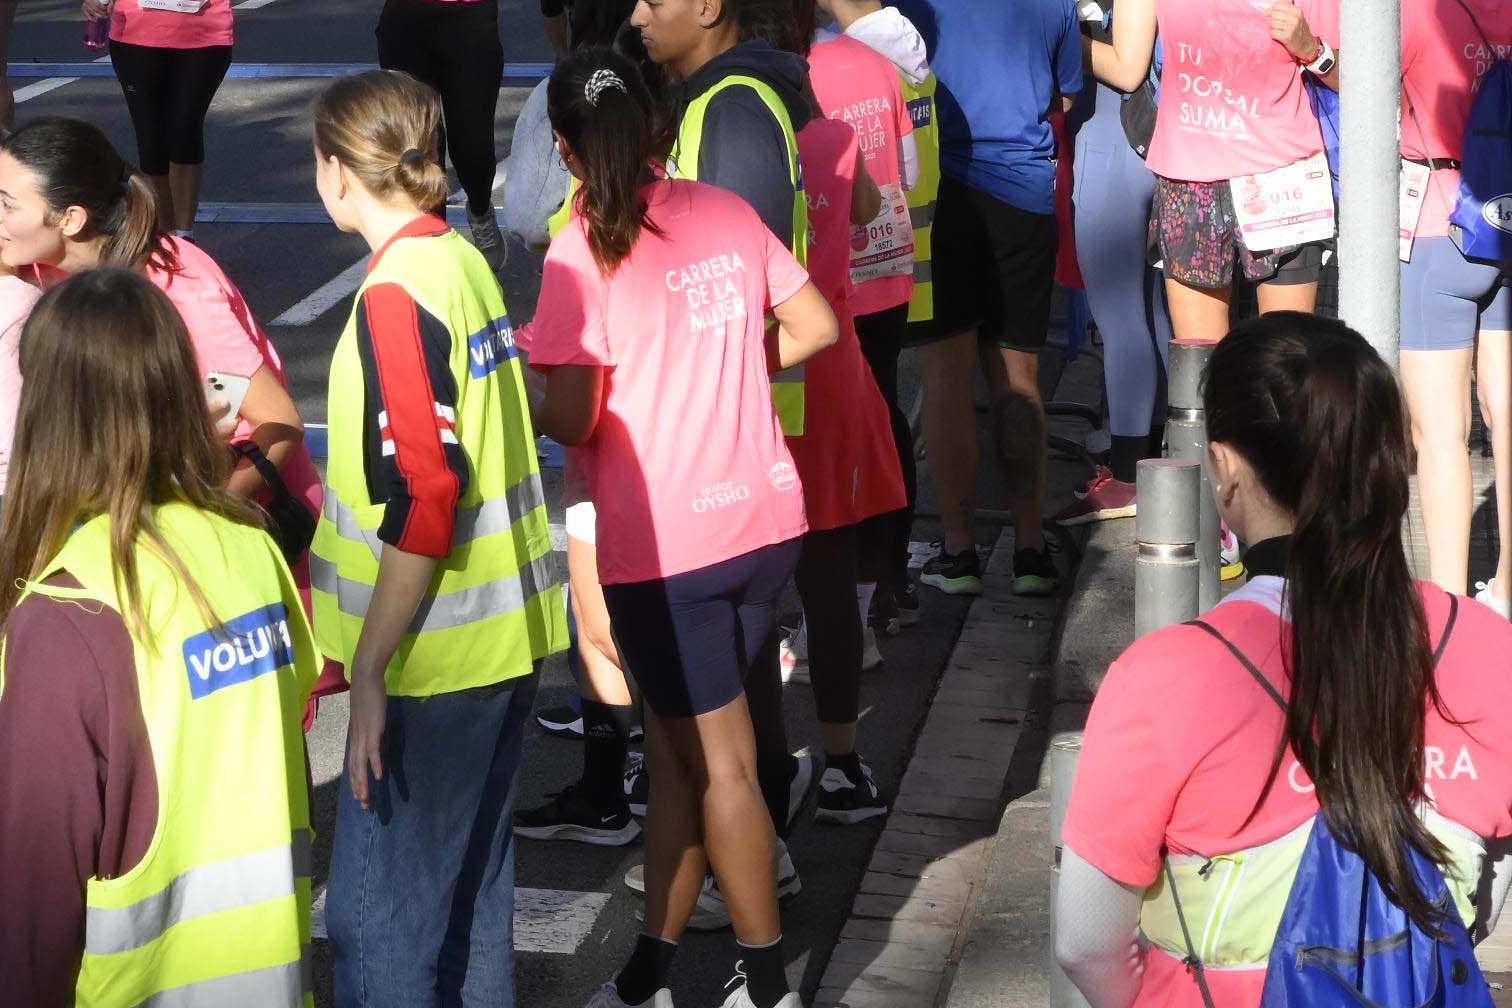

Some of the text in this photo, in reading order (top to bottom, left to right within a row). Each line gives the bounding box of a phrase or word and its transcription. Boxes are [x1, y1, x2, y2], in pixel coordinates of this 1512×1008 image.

[1177, 42, 1202, 66] TU
[868, 118, 883, 131] LA
[1179, 102, 1248, 133] SUMA
[870, 222, 894, 240] 016
[874, 239, 893, 251] 18572
[665, 251, 745, 292] CARRERA
[686, 278, 738, 310] DE LA
[689, 296, 747, 333] MUJER
[692, 486, 749, 513] OYSHO
